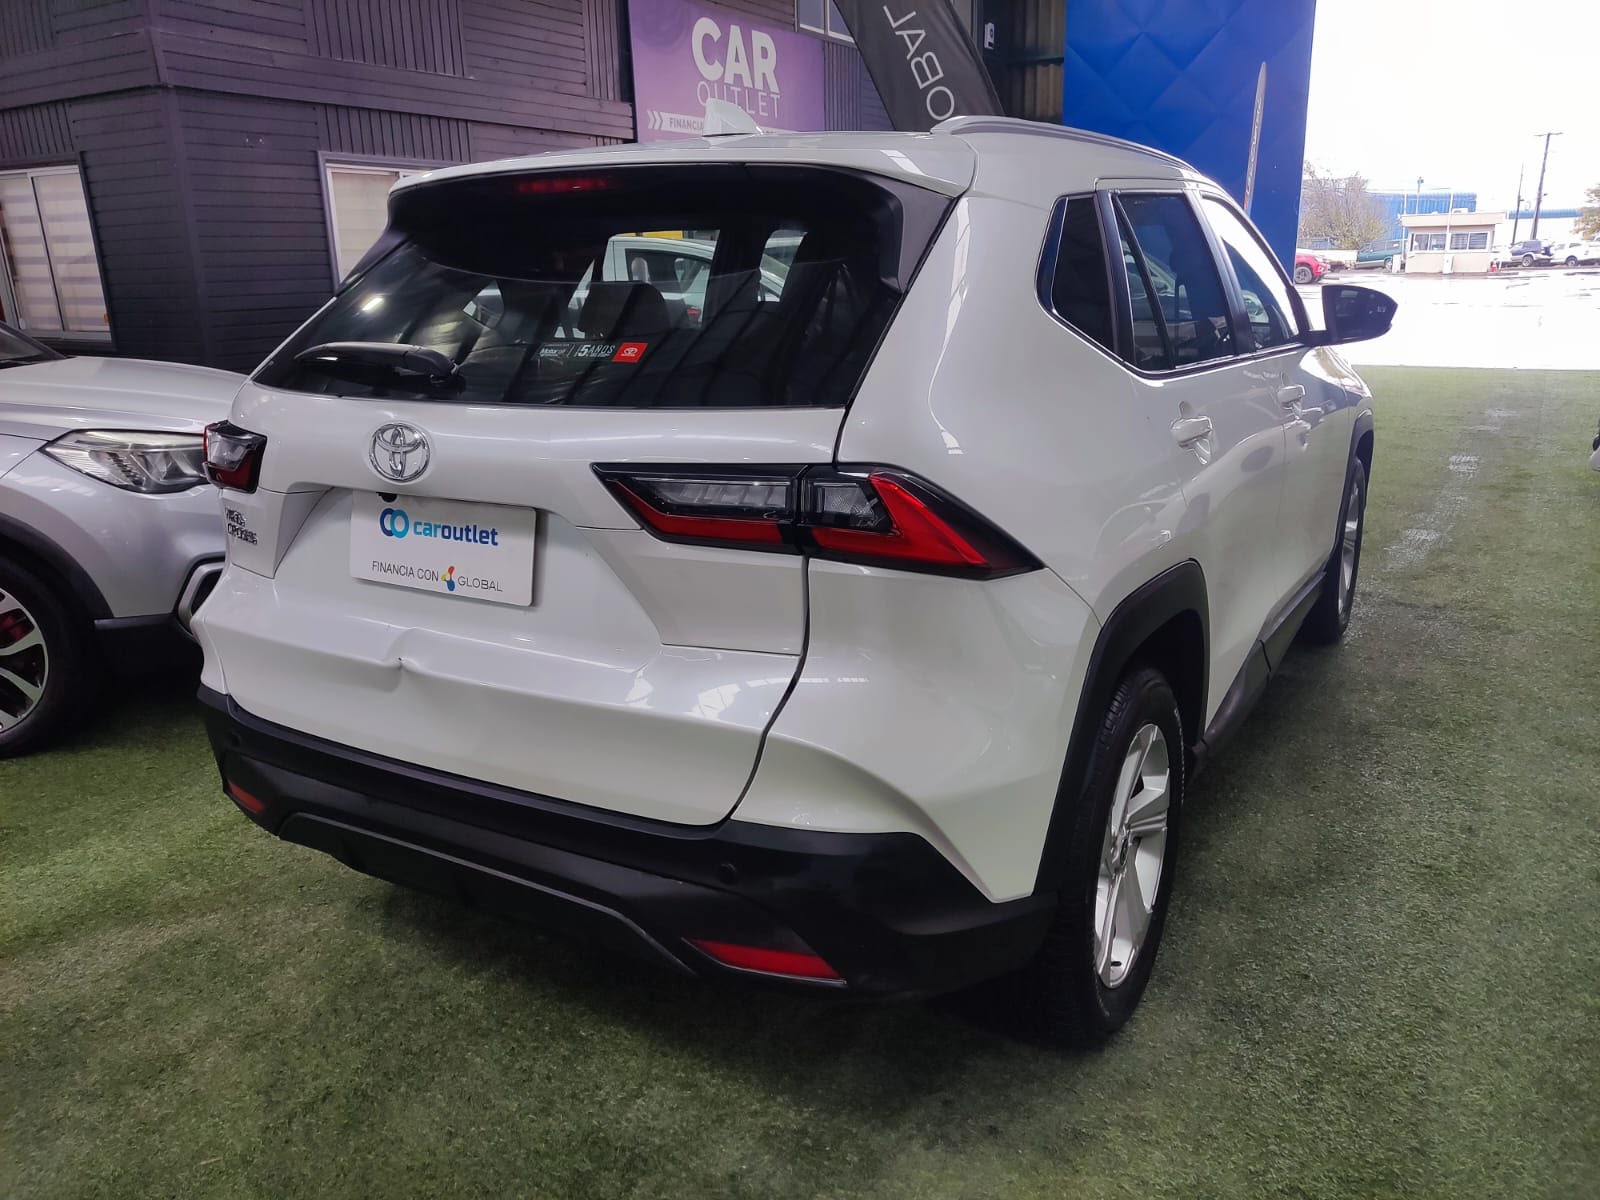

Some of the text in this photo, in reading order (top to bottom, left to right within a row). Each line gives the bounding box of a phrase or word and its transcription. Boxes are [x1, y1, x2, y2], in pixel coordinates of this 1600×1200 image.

[691, 17, 780, 93] CAR
[696, 80, 781, 119] OUTLET
[413, 520, 499, 546] caroutlet
[372, 560, 503, 592] FINANCIA CON GLOBAL
